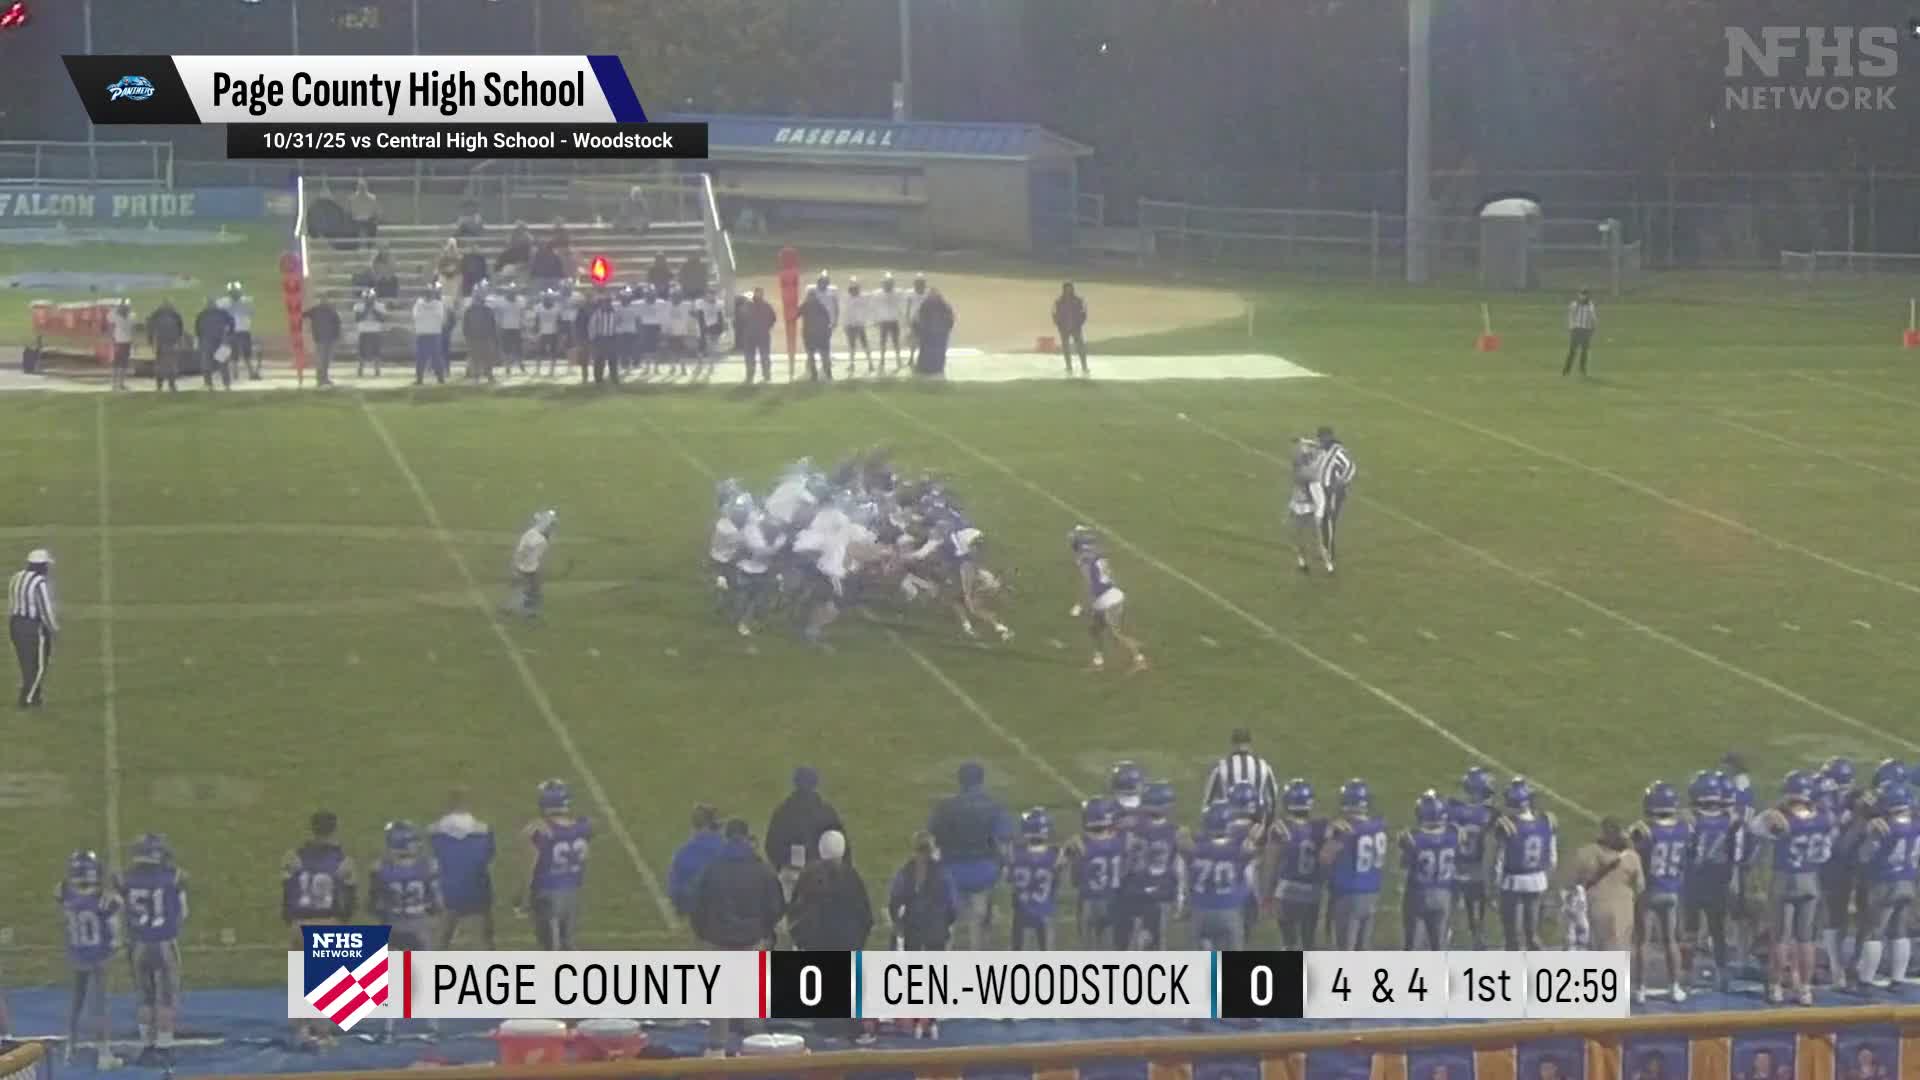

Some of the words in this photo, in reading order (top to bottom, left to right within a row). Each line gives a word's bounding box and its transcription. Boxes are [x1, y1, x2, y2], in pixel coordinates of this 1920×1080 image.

[775, 127, 893, 146] BASEBALL
[112, 193, 196, 218] PRIDE
[1088, 855, 1120, 889] 31
[1193, 857, 1234, 895] 70
